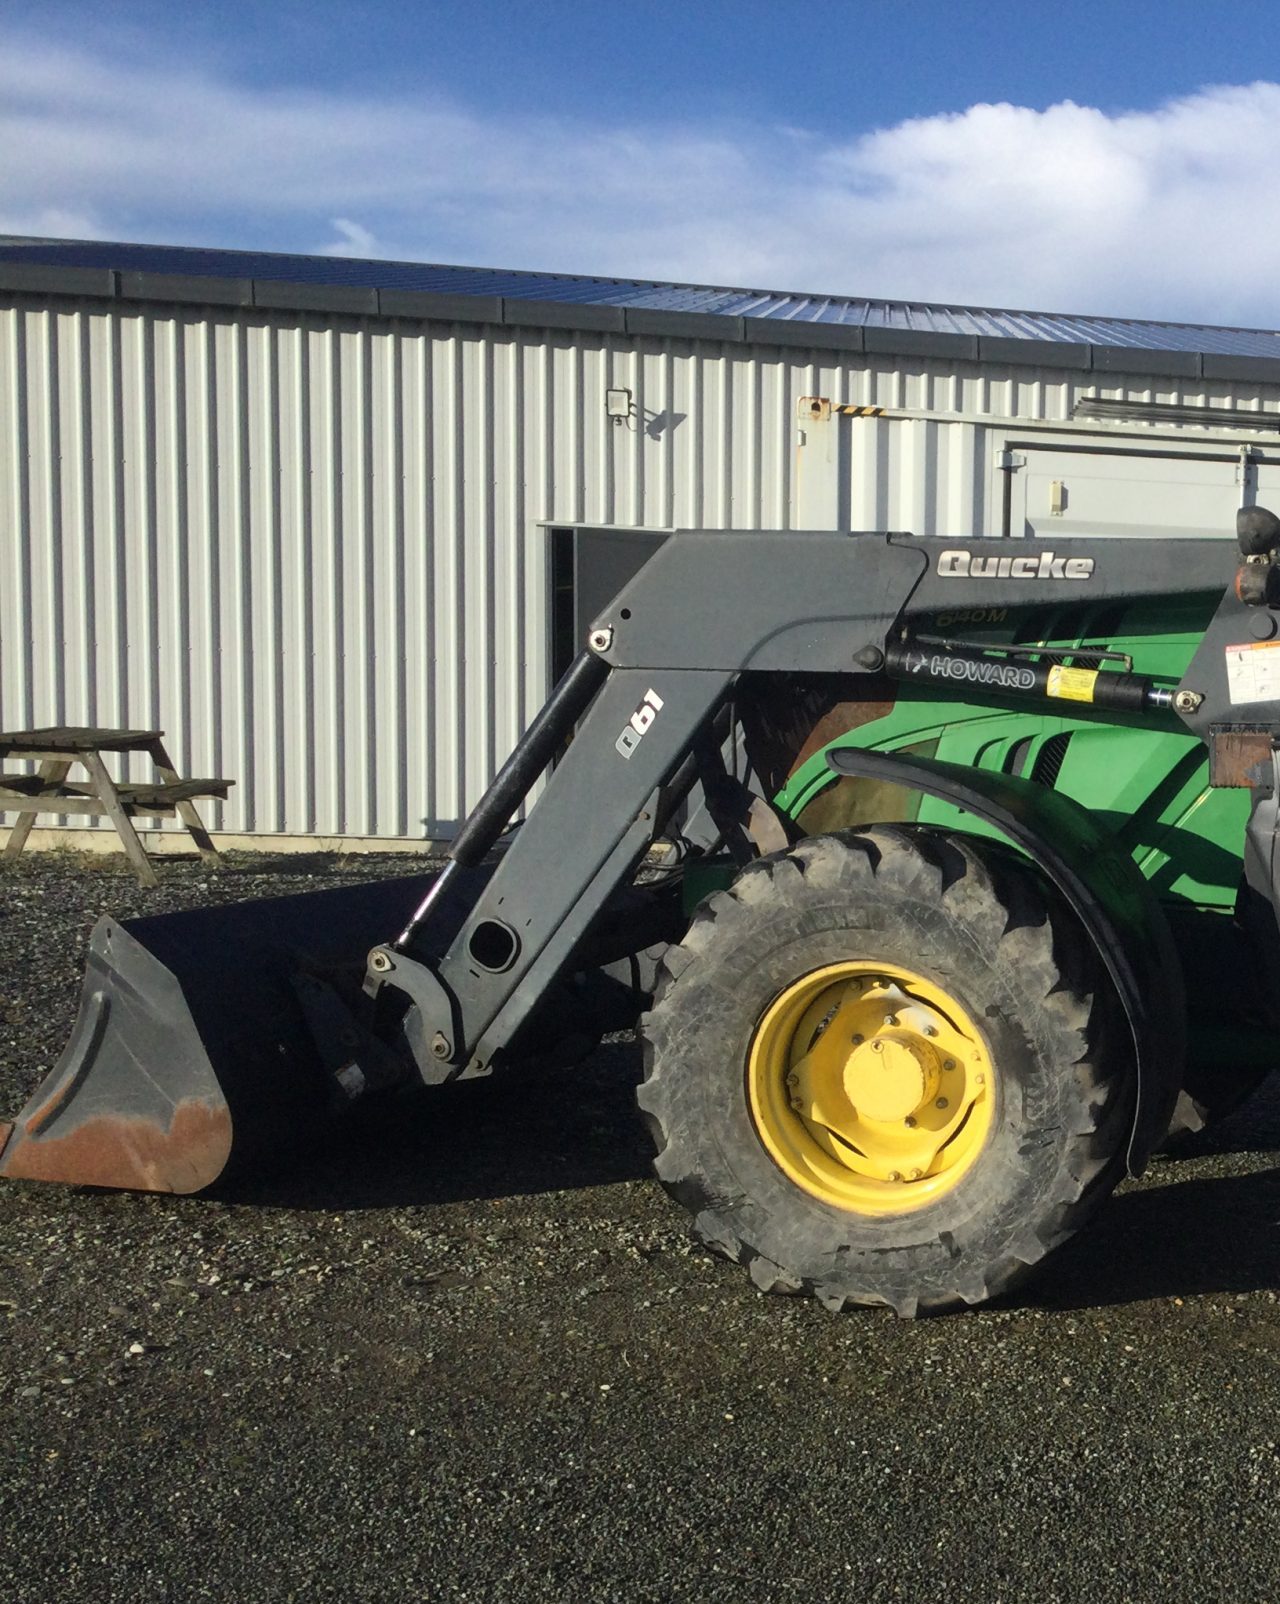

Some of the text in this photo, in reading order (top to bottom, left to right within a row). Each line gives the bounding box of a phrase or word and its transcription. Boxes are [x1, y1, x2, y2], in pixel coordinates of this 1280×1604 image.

[937, 550, 1095, 579] Quicke
[930, 656, 1036, 689] HOWARD
[615, 688, 665, 760] Q61
